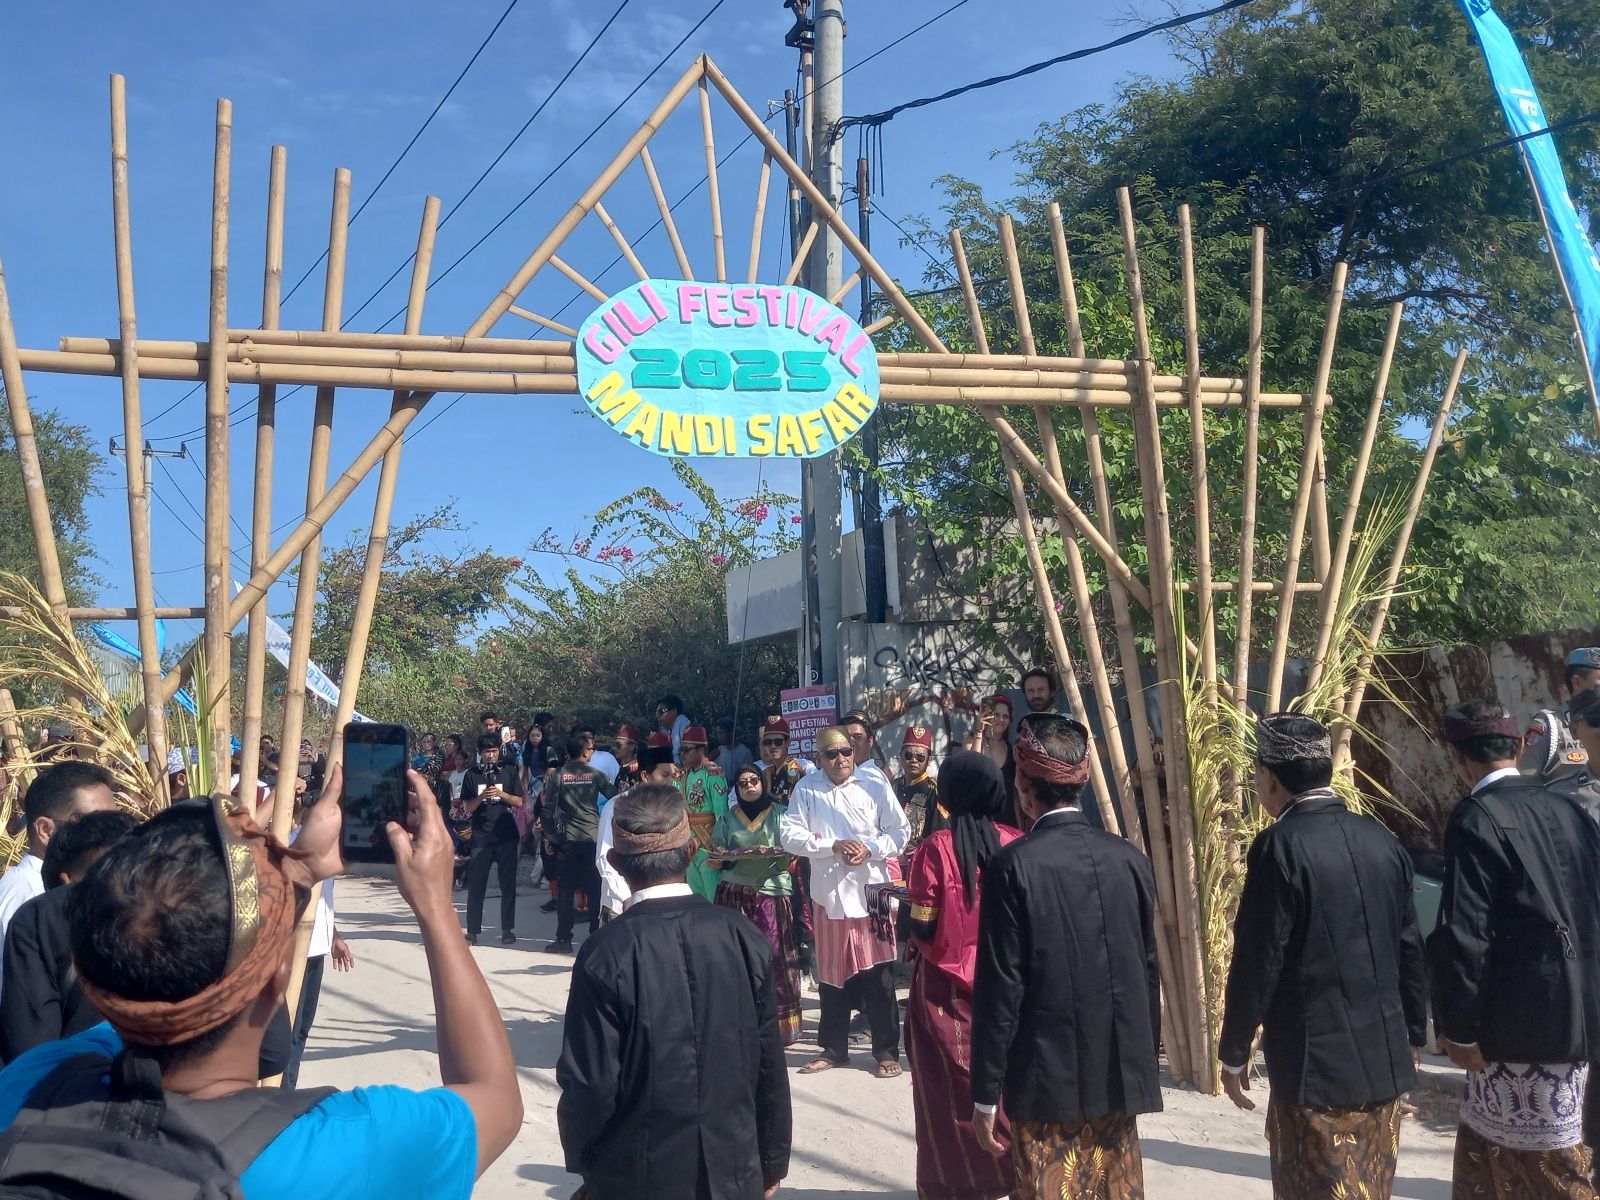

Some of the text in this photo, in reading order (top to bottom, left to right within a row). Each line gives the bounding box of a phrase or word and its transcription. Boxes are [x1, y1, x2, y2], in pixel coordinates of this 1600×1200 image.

[583, 283, 870, 377] GILI FESTIVAL
[630, 348, 831, 392] 2025
[586, 370, 875, 456] MANDI SAFAR
